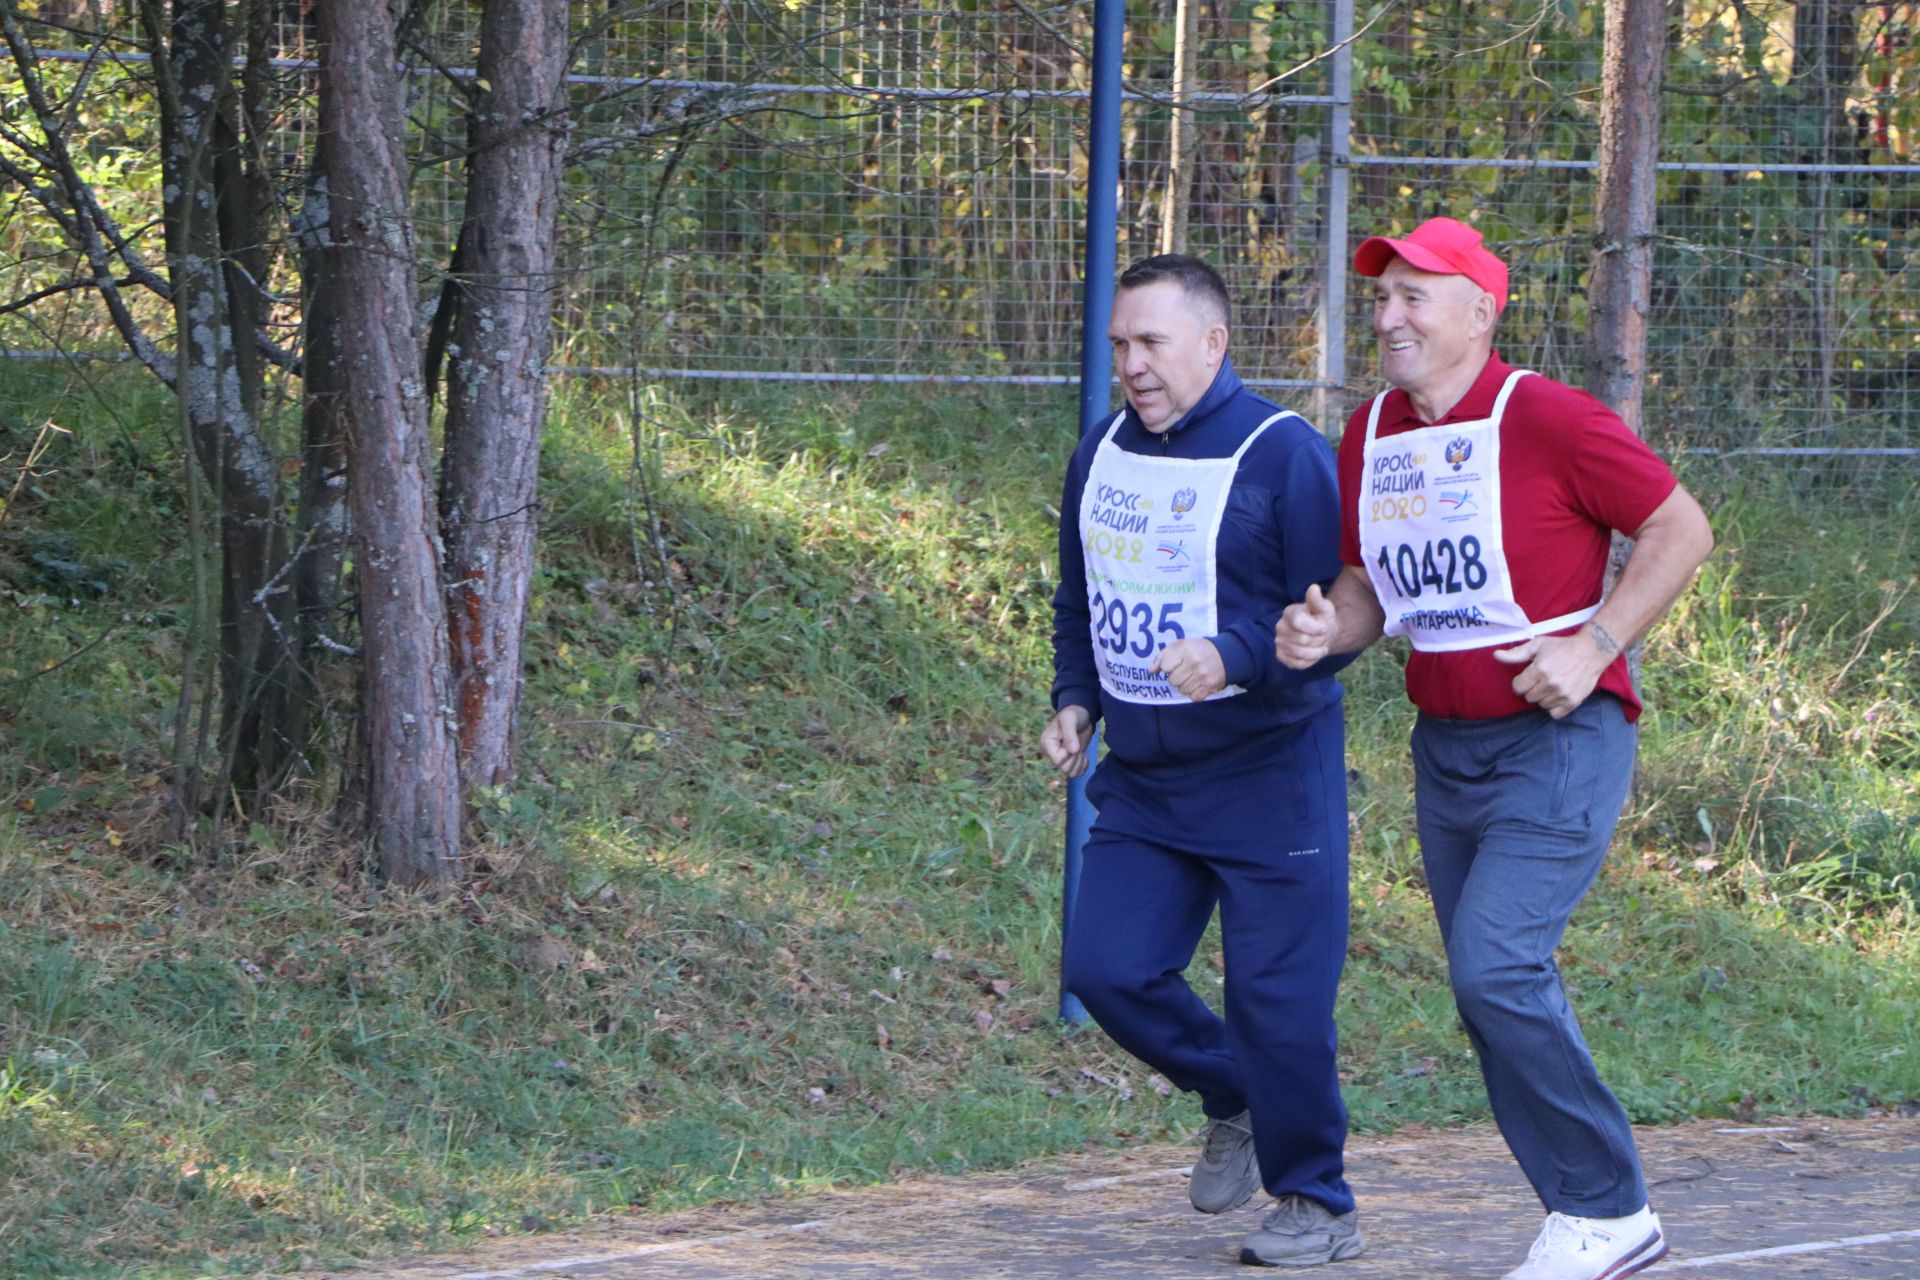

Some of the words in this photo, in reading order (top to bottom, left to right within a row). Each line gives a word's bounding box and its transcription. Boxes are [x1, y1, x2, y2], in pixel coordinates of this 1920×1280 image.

[1373, 452, 1413, 475] КРОСС
[1096, 482, 1141, 511] КРОСС
[1372, 470, 1425, 496] НАЦИИ
[1090, 503, 1149, 534] НАЦИИ
[1371, 494, 1427, 523] 2020
[1086, 527, 1143, 563] 2022
[1378, 535, 1487, 598] 10428
[1093, 591, 1186, 659] 2935
